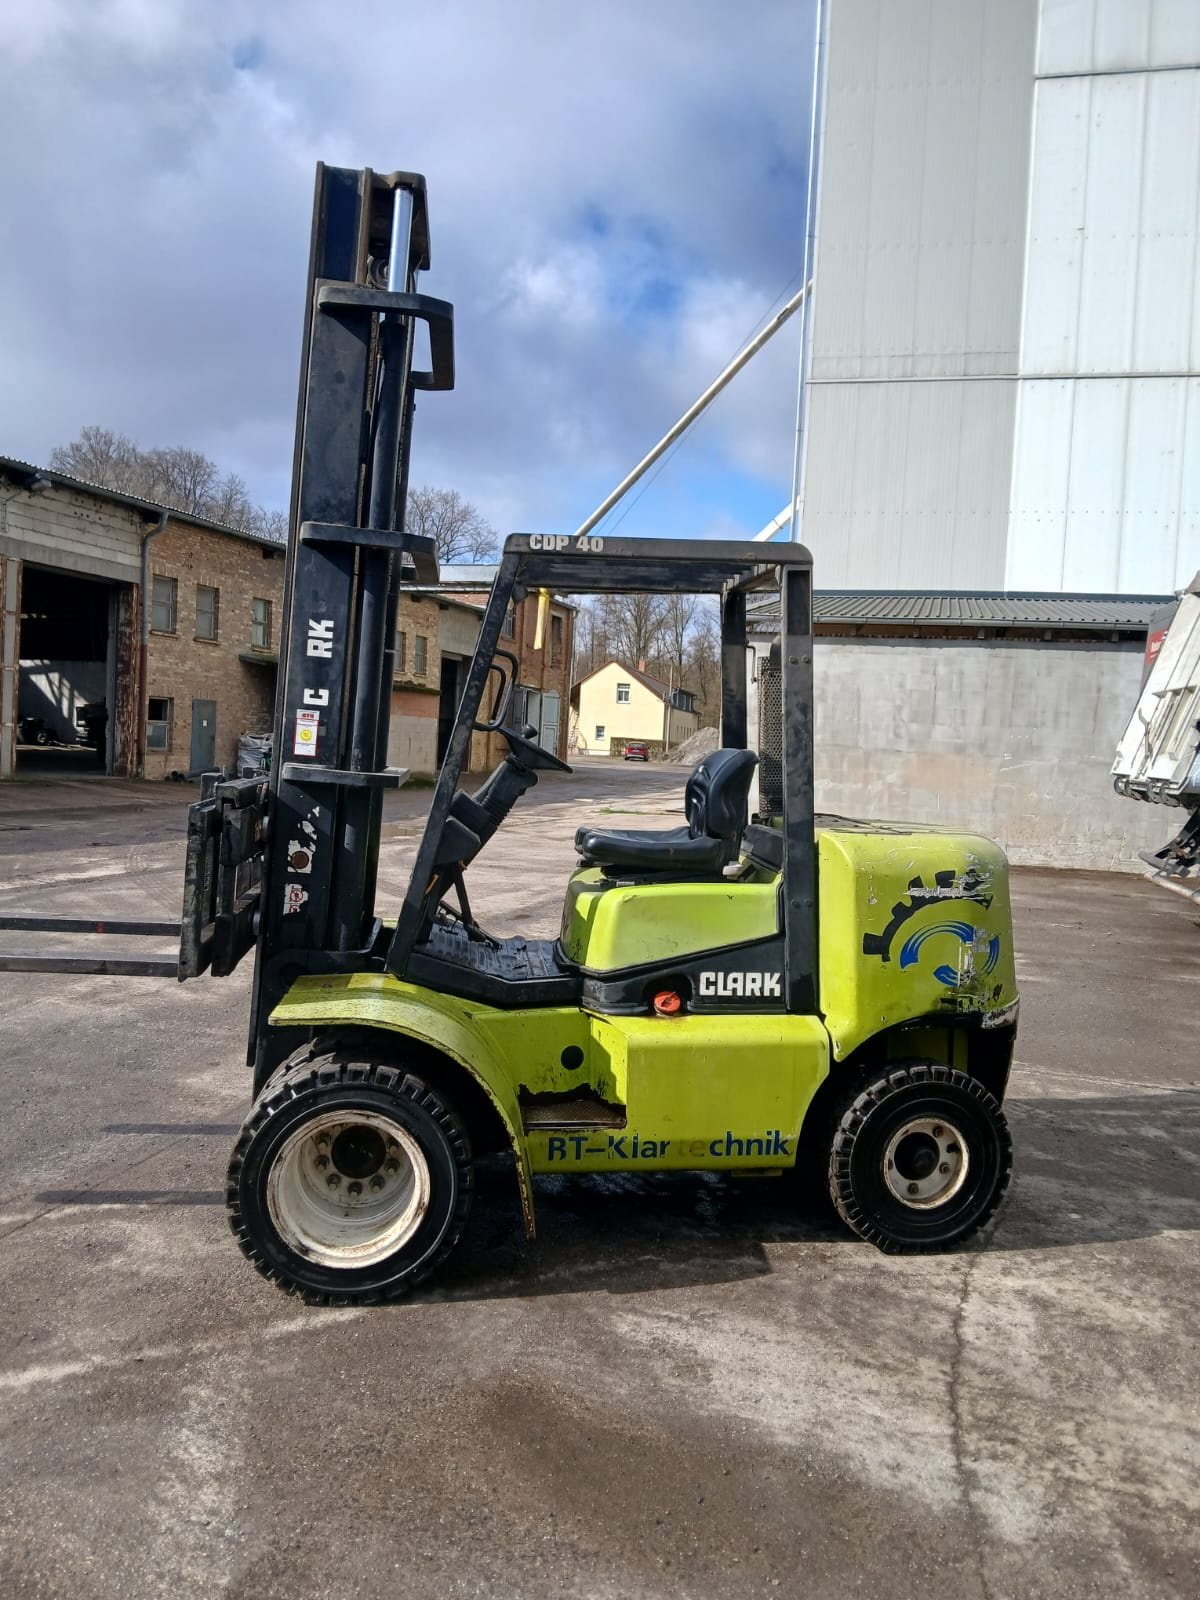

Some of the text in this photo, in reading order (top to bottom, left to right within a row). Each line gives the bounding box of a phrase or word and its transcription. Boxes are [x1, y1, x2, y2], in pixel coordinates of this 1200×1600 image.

[529, 533, 604, 553] CDP 40
[699, 971, 781, 997] CLARK
